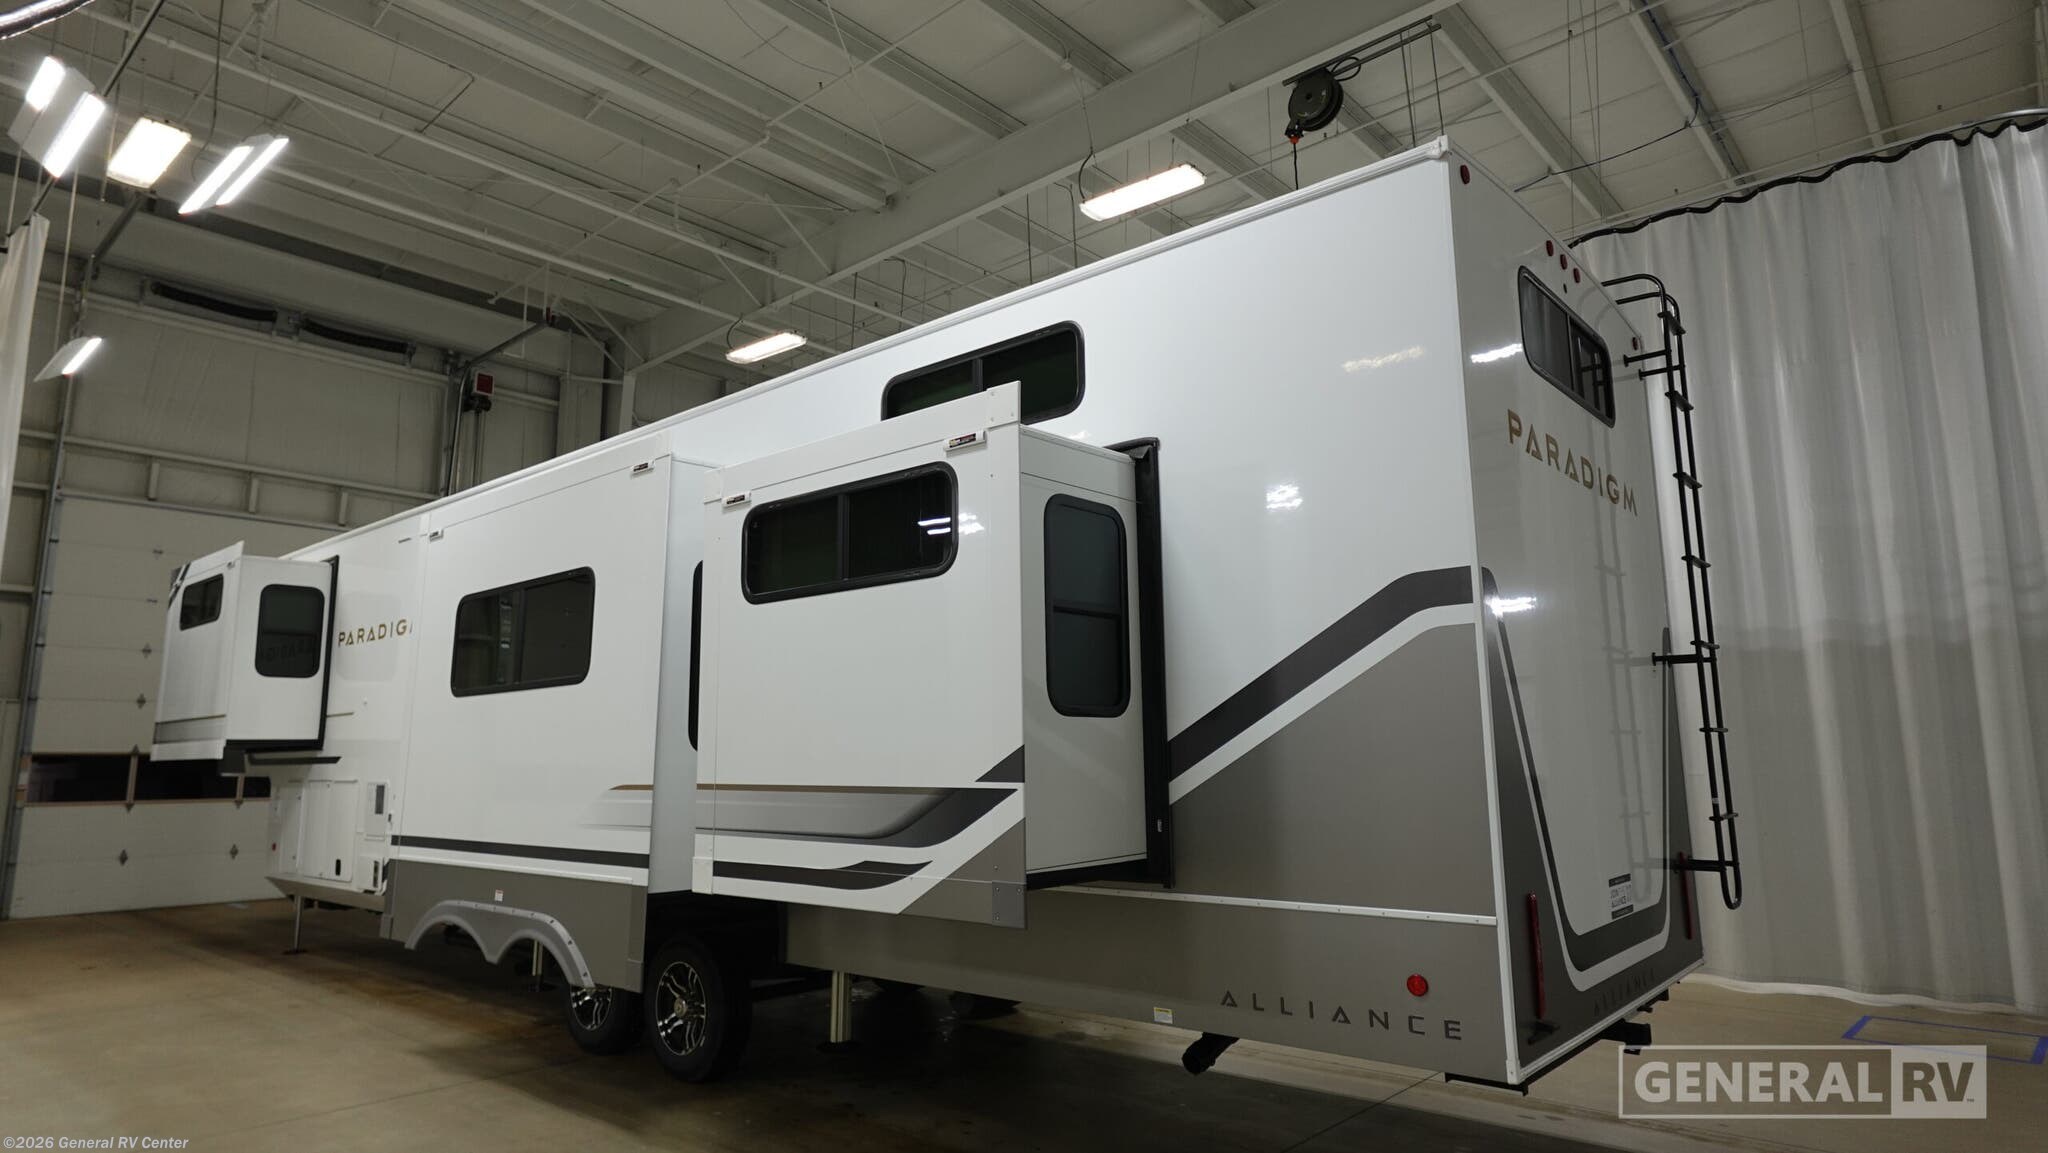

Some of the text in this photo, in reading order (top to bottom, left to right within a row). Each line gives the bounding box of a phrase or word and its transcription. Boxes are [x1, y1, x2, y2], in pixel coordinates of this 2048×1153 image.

[1508, 409, 1638, 517] PARADIGM
[338, 619, 413, 647] PARADIG
[1220, 990, 1462, 1041] ALLIANCE
